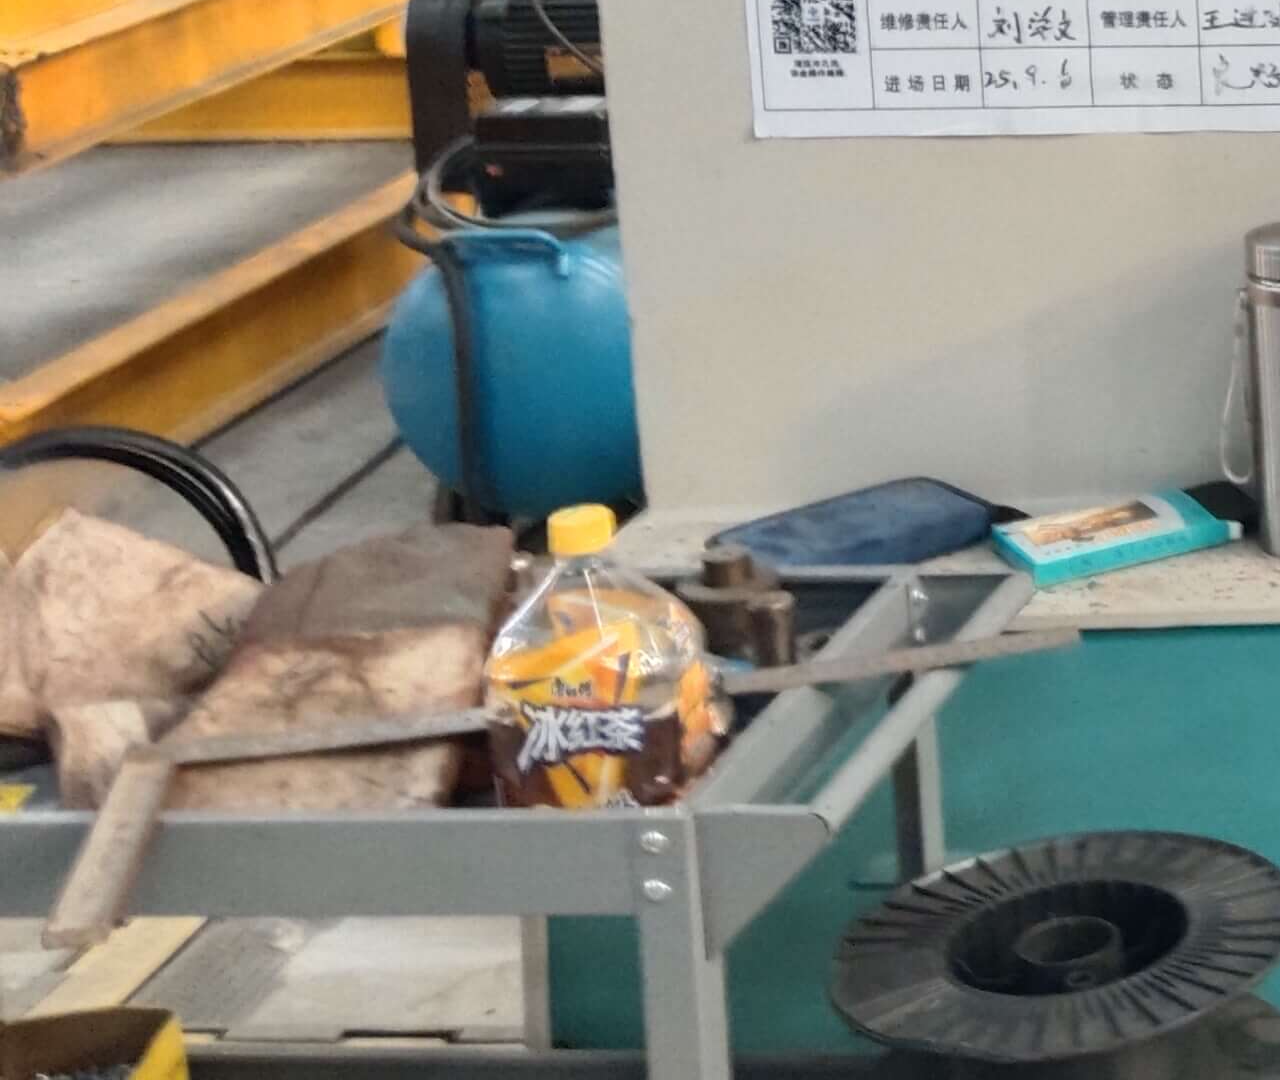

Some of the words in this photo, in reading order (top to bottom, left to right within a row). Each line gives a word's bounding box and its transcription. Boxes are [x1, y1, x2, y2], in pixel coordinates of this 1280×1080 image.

[880, 12, 968, 31] 维修责任人
[1100, 10, 1187, 29] 管理责任人
[884, 74, 970, 93] 进场日期
[1119, 71, 1174, 90] 状态
[517, 703, 646, 773] 冰红茶
